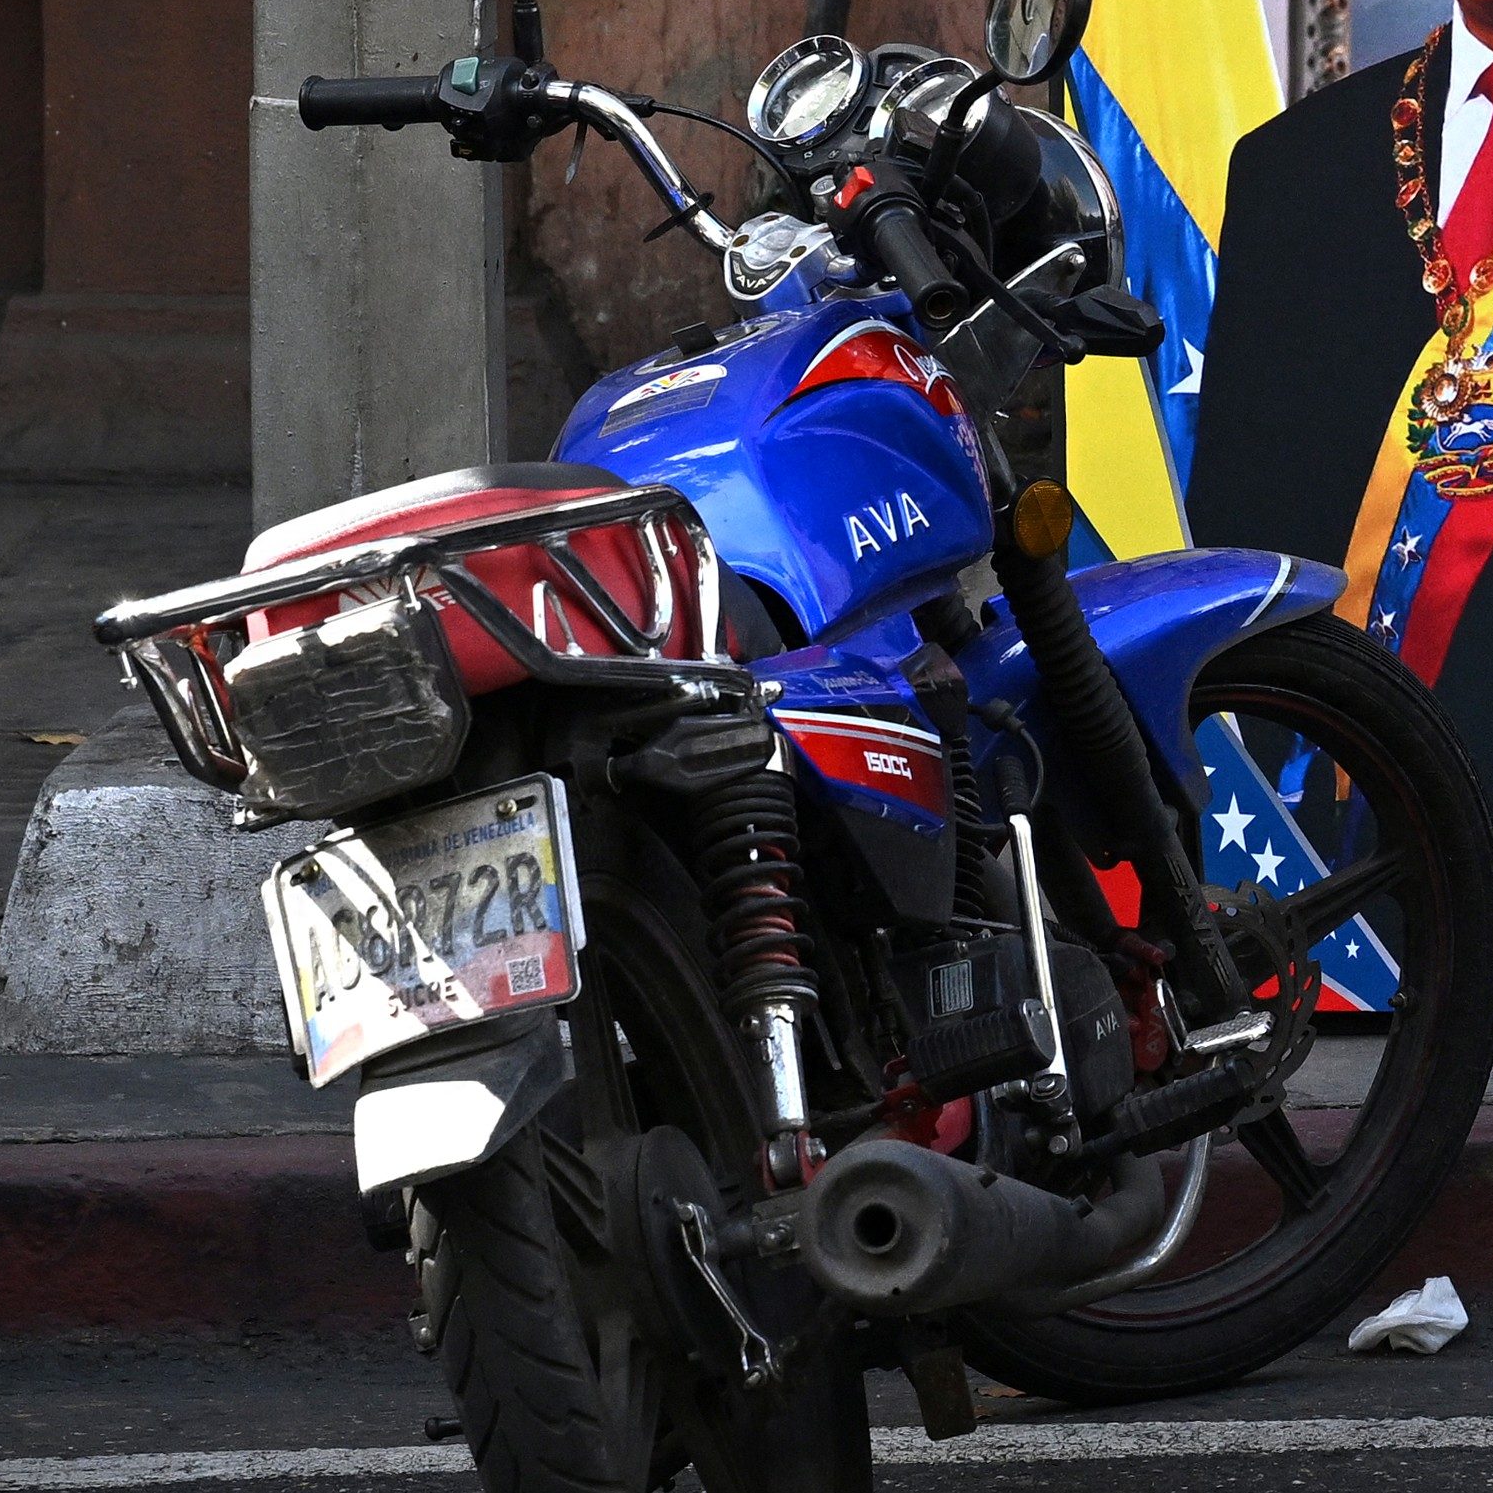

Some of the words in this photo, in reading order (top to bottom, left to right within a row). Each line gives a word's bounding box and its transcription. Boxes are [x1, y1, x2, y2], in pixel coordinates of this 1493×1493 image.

[736, 274, 767, 288] AVA
[843, 491, 930, 561] AVA
[389, 975, 458, 1017] SUCRE
[1096, 1010, 1120, 1040] AVA
